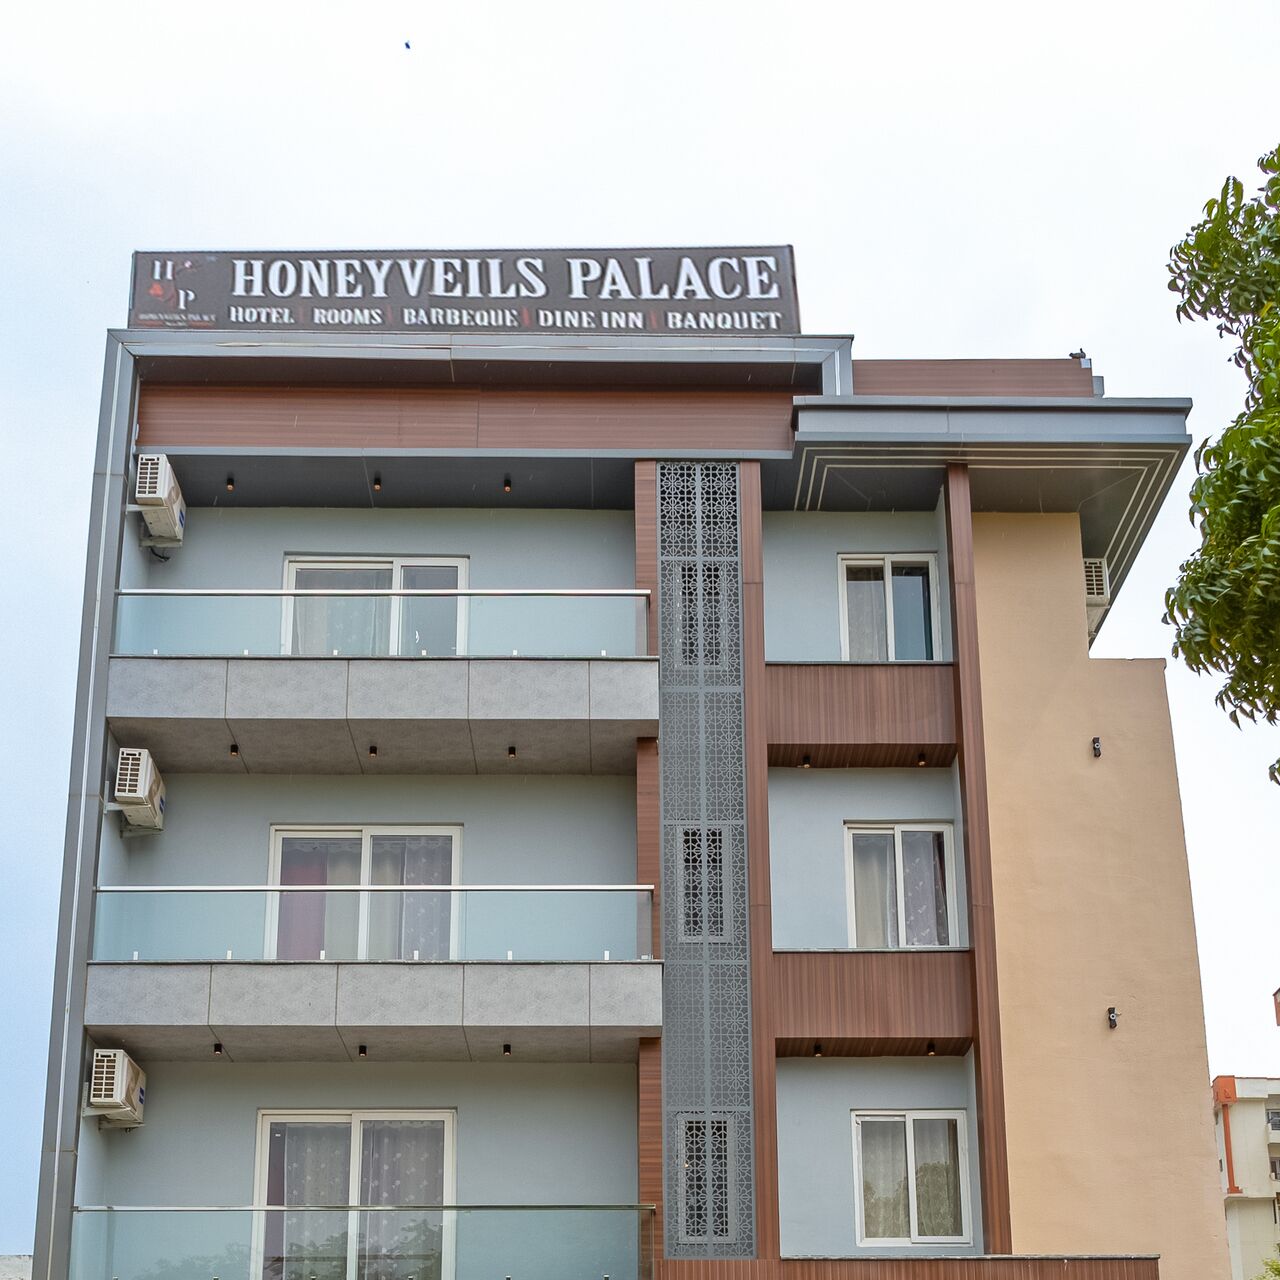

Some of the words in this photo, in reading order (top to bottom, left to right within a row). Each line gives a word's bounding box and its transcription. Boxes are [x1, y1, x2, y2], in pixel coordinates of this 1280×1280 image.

[231, 258, 548, 298] HONEYVEILS
[566, 256, 780, 300] PALACE
[229, 306, 295, 324] HOTEL
[313, 307, 383, 325] ROOMS
[402, 307, 519, 328] BARBEQUE
[538, 309, 595, 329] DINE
[601, 310, 644, 329] INN
[667, 311, 782, 330] BANQUET
